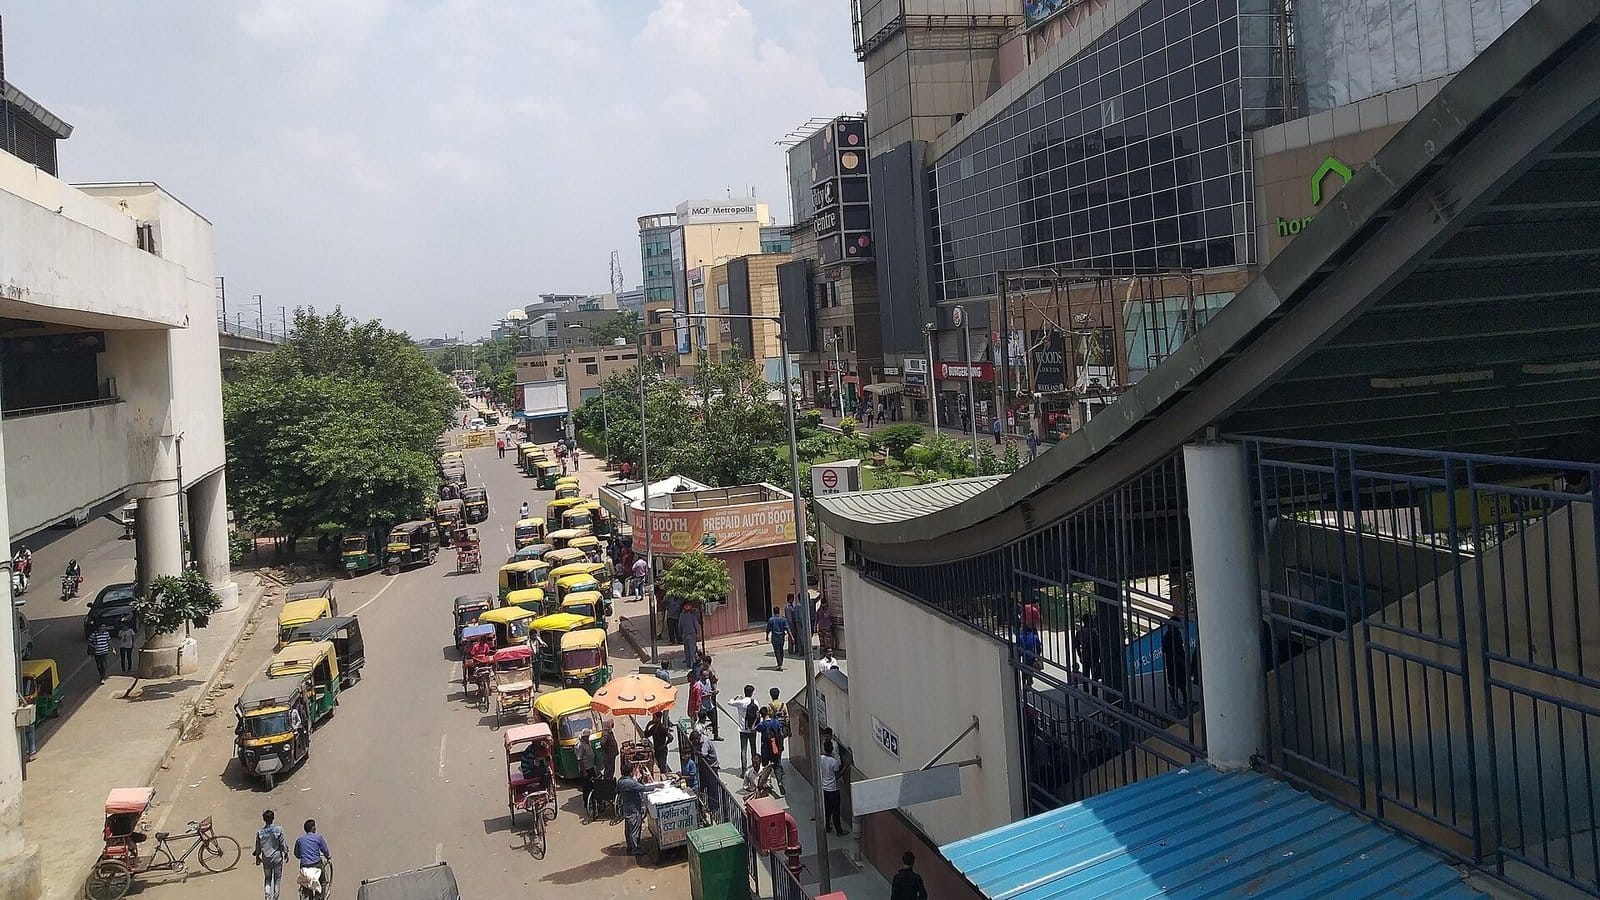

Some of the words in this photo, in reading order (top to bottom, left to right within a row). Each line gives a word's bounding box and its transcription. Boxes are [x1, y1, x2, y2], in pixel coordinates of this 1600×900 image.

[691, 207, 710, 215] MGF
[712, 206, 754, 214] Metropolis
[1035, 351, 1062, 364] WOODS
[653, 517, 687, 531] BOOTH
[703, 515, 740, 531] PREPAID
[742, 511, 766, 527] AUTO
